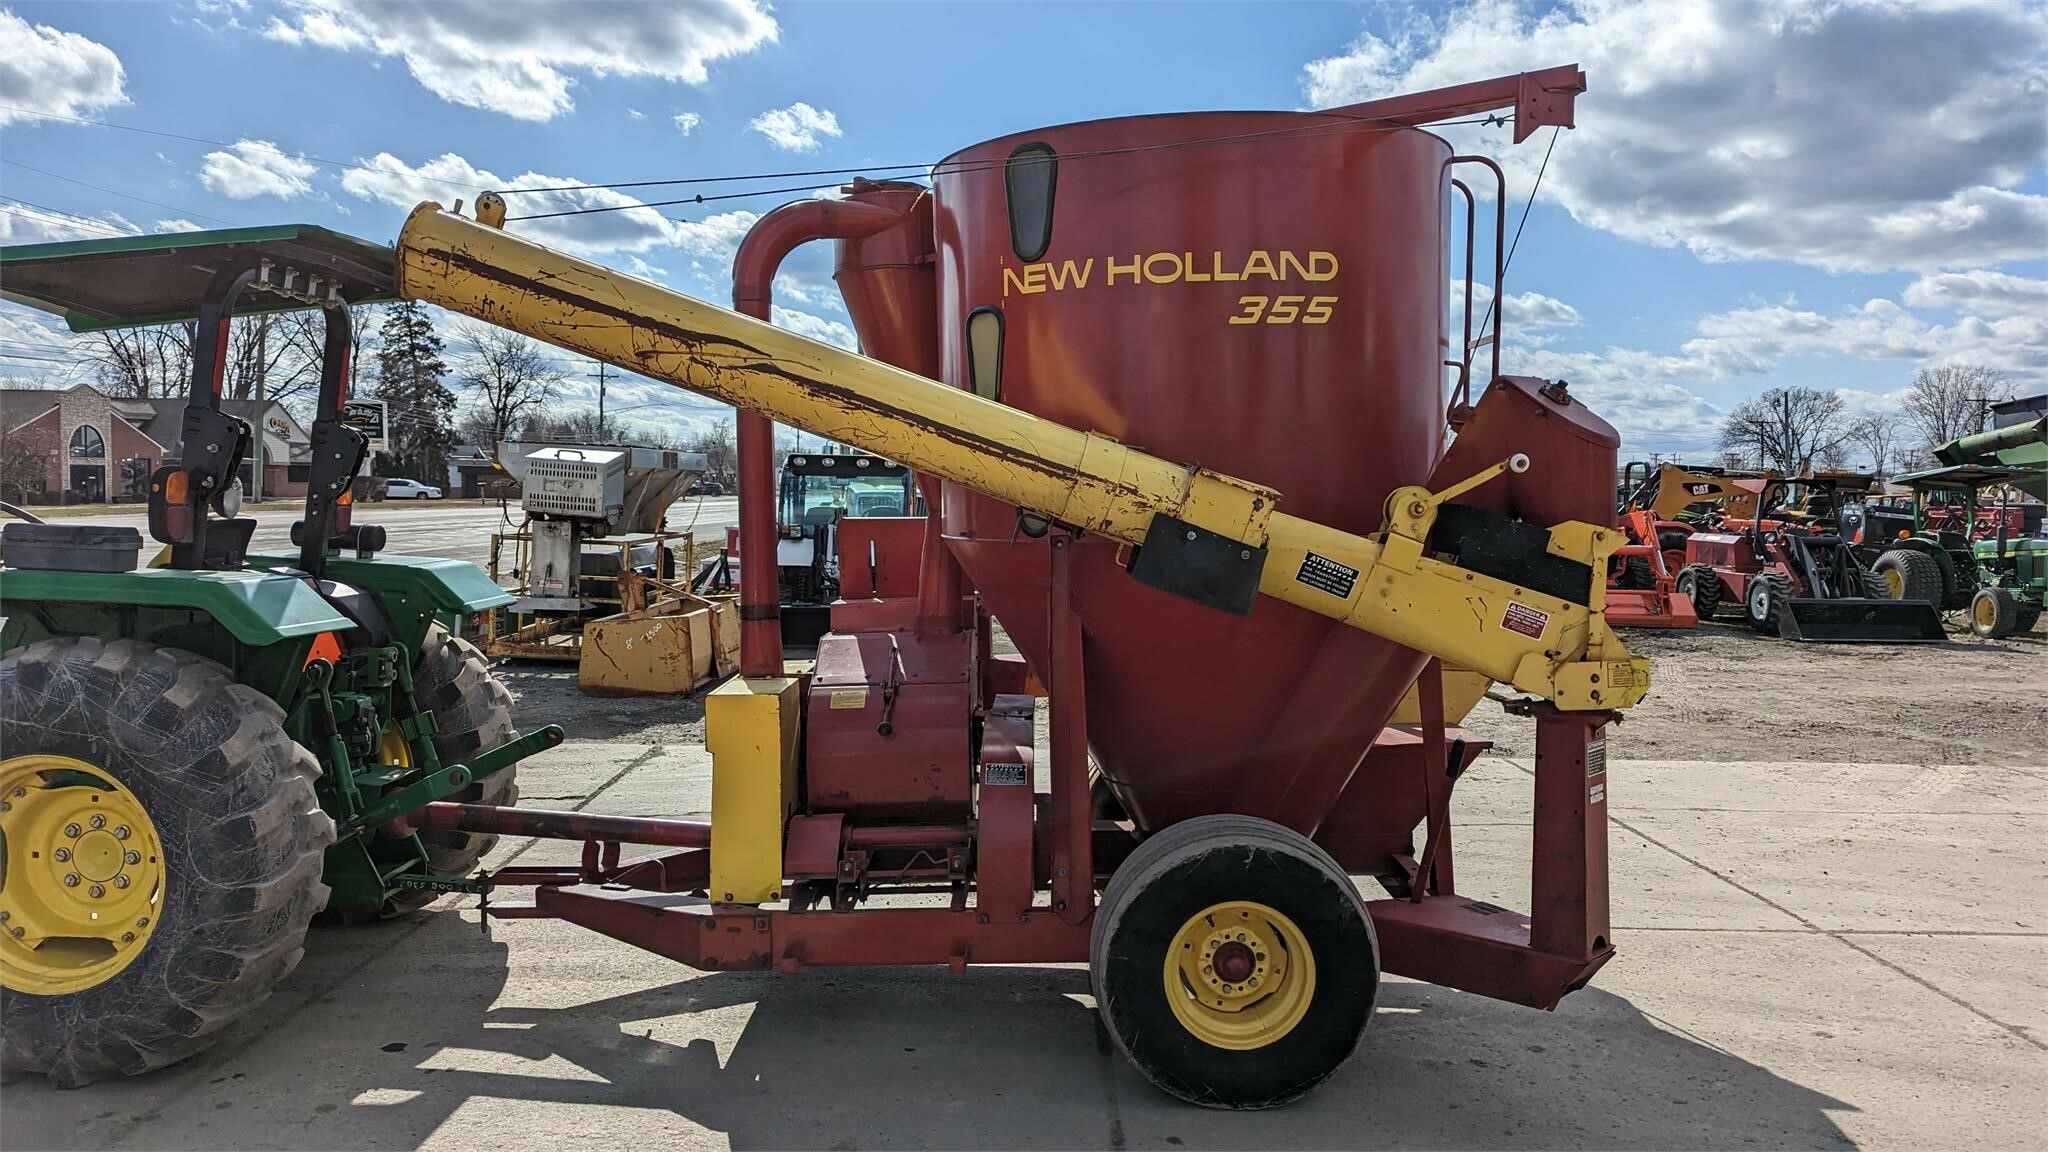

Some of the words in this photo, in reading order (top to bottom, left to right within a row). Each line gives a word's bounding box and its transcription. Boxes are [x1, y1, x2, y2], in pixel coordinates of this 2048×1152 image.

[1003, 258, 1094, 297] NEW
[1107, 250, 1339, 286] HOLLAND
[1228, 295, 1339, 325] 355
[1692, 483, 1709, 496] CAT
[1309, 555, 1354, 577] ATTENTION
[1516, 606, 1541, 618] DANGER
